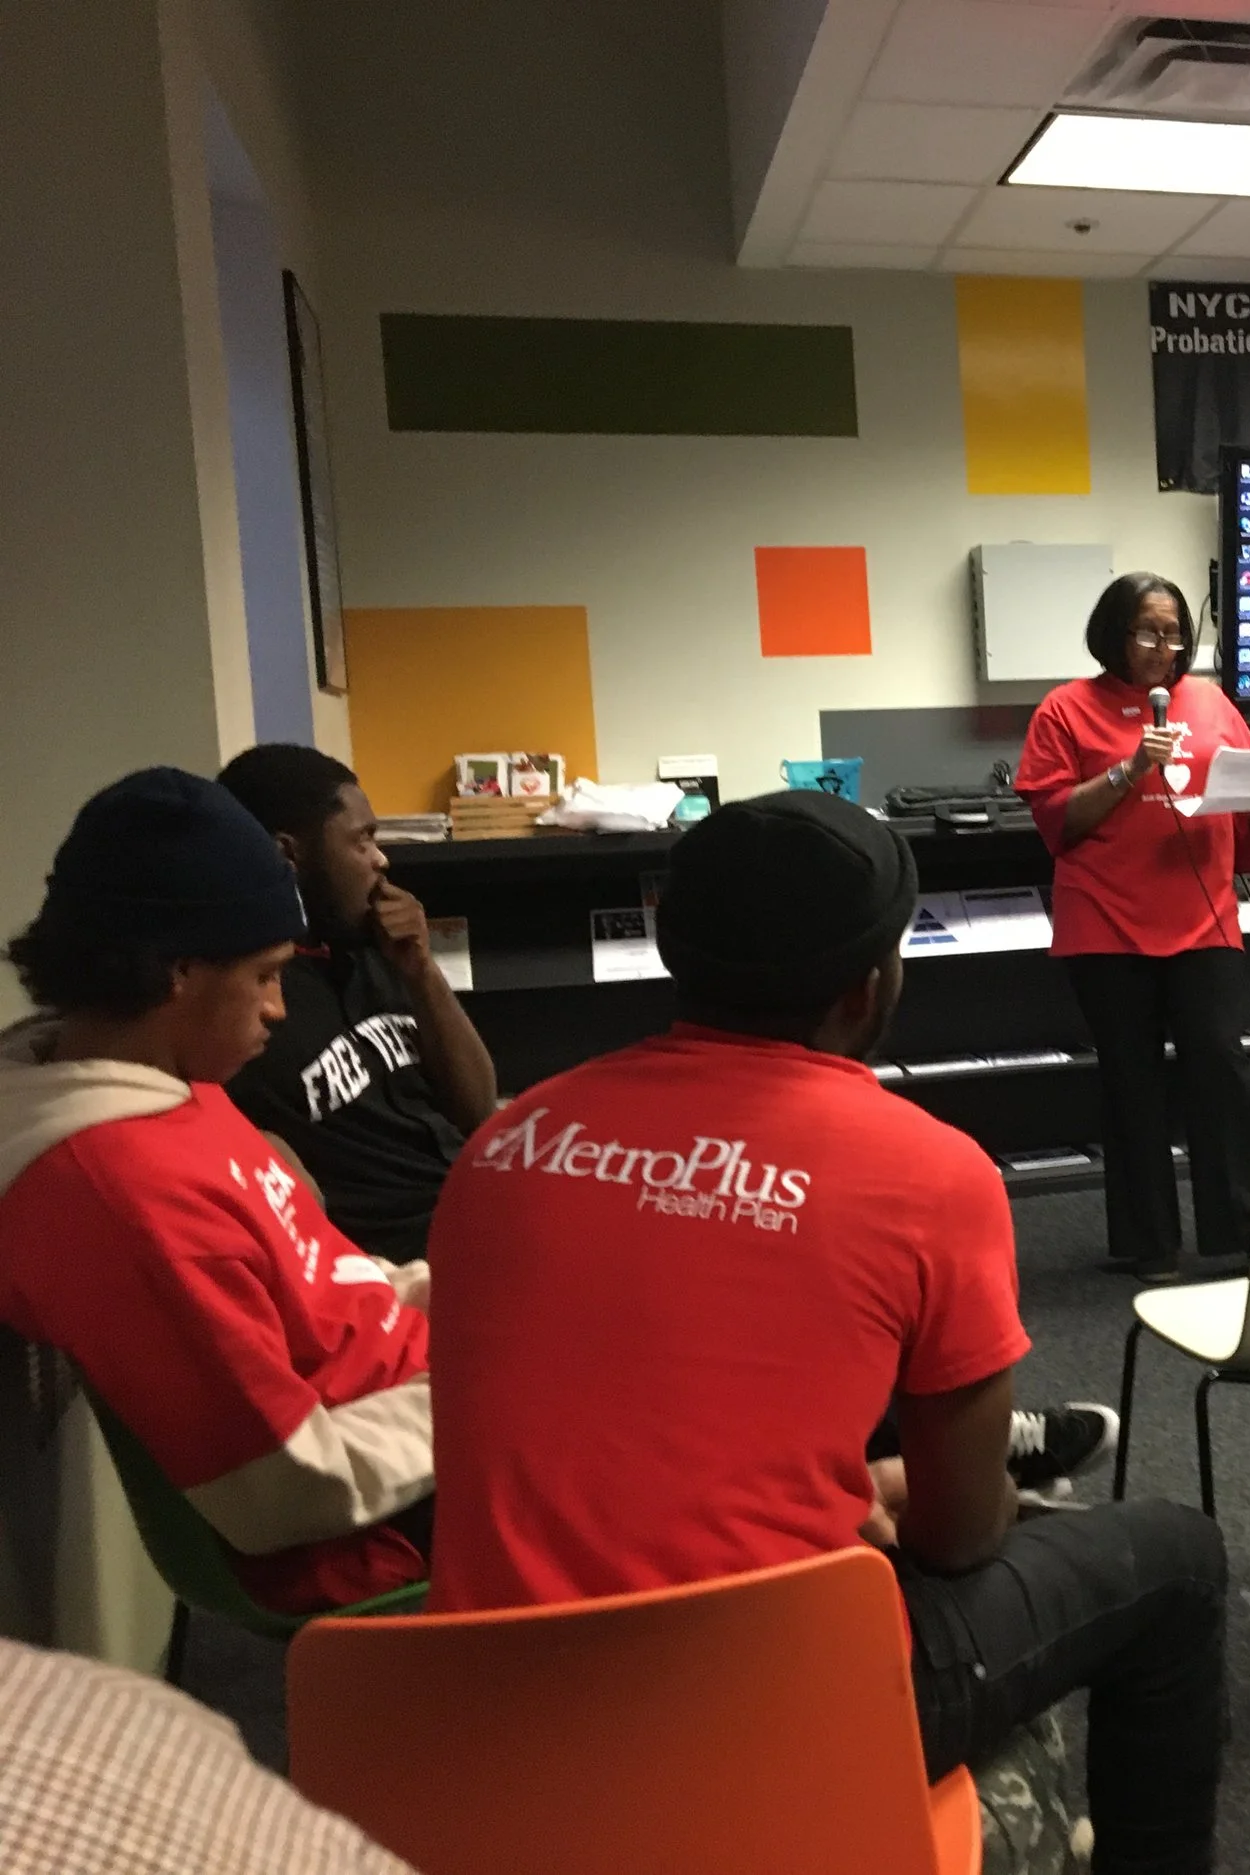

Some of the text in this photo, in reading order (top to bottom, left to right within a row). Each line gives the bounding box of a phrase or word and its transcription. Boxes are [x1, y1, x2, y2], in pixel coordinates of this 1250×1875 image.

[1168, 291, 1250, 319] NYC
[300, 1032, 371, 1123] FREE
[473, 1107, 811, 1208] MetroPlus
[636, 1185, 799, 1235] Health Plan
